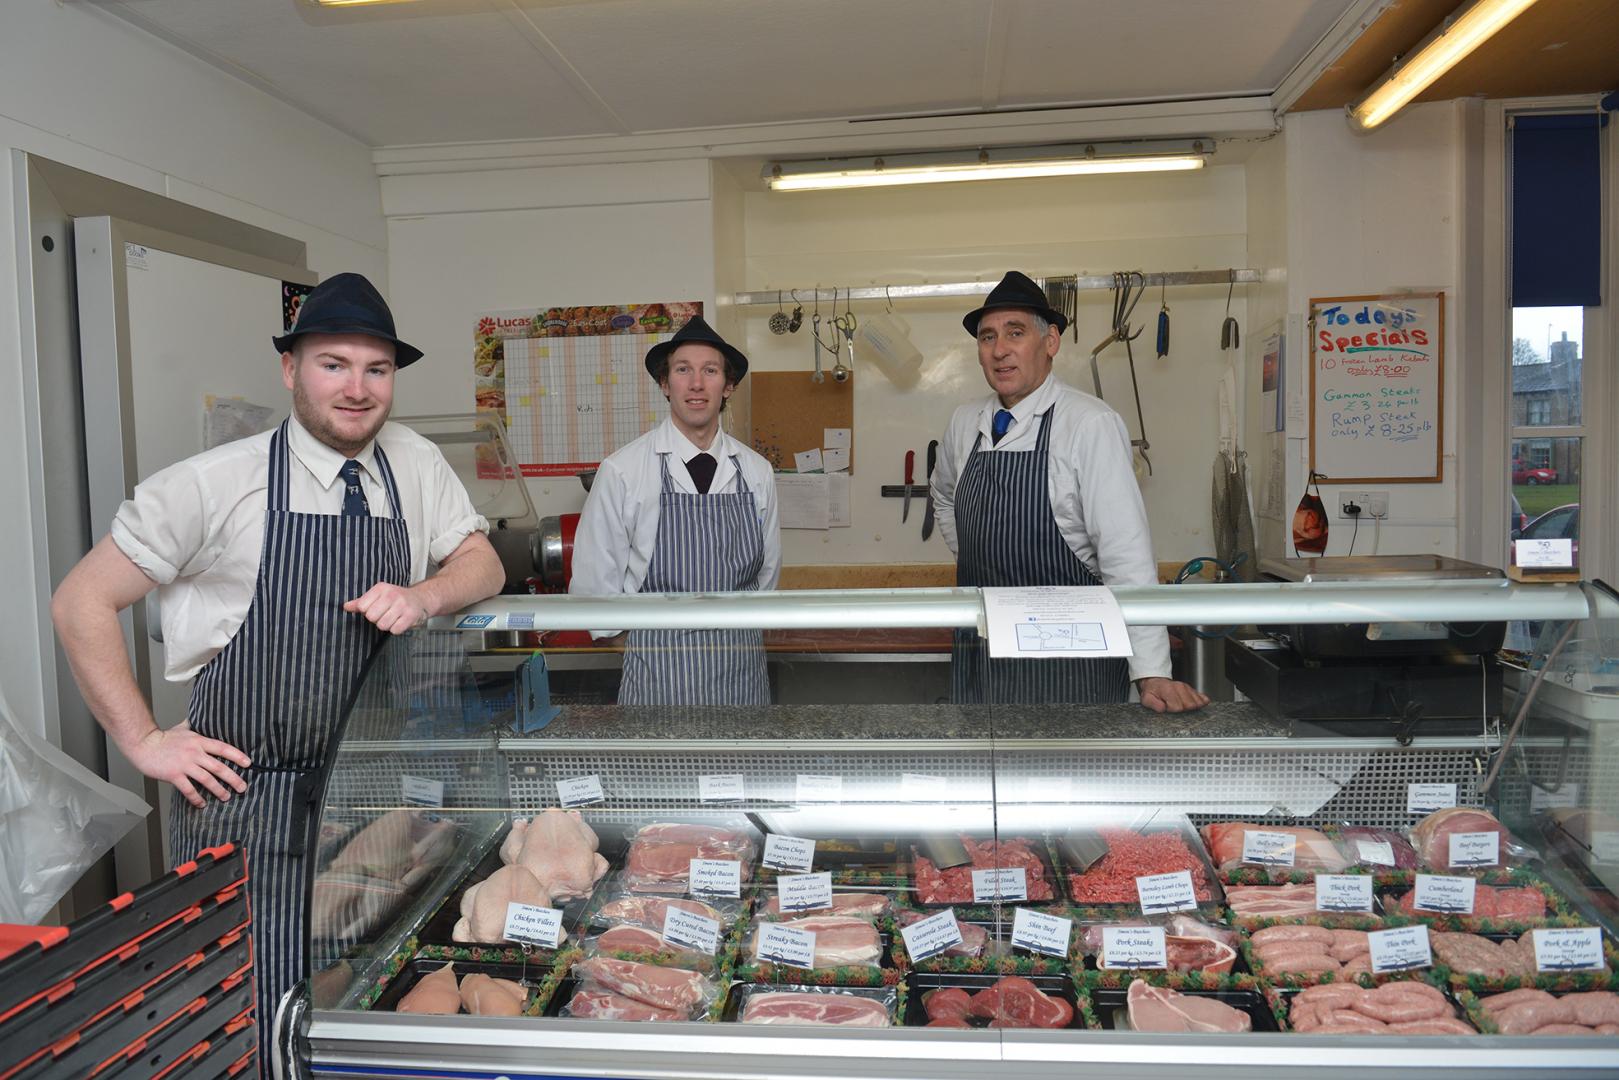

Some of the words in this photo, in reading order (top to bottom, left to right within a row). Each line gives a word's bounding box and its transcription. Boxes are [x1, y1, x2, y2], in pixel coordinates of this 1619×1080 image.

[497, 317, 532, 328] Lucas
[1319, 328, 1428, 352] Specials
[1321, 358, 1336, 371] 10
[1324, 388, 1372, 402] Gammon
[1332, 412, 1372, 427] Rump
[1380, 411, 1417, 422] Steak
[773, 843, 790, 851] Bacon
[790, 845, 806, 855] Chops
[1458, 841, 1470, 849] Beef
[697, 868, 717, 877] Smoked
[1000, 875, 1016, 884] Steak
[1174, 881, 1188, 889] Chops
[786, 884, 806, 892] Middle
[1328, 883, 1347, 891] Thick
[1347, 884, 1362, 892] Pork
[1427, 883, 1464, 894] Cumberland
[512, 912, 536, 924] Chicken
[536, 916, 555, 926] Fillets
[669, 916, 681, 927] Dry
[681, 919, 698, 931] Cured
[697, 925, 715, 936] Bacon
[910, 925, 936, 943] Casserole
[936, 918, 953, 932] Steak
[1027, 919, 1042, 930] Shin
[1041, 923, 1057, 935] Beef
[765, 932, 789, 945] Streaky
[789, 938, 808, 947] Bacon
[1115, 938, 1133, 946] Pork
[1132, 938, 1153, 946] Steaks
[1384, 939, 1400, 948] Thin
[1400, 937, 1417, 947] Pork
[1543, 939, 1561, 948] Pork
[1570, 937, 1591, 948] Apple
